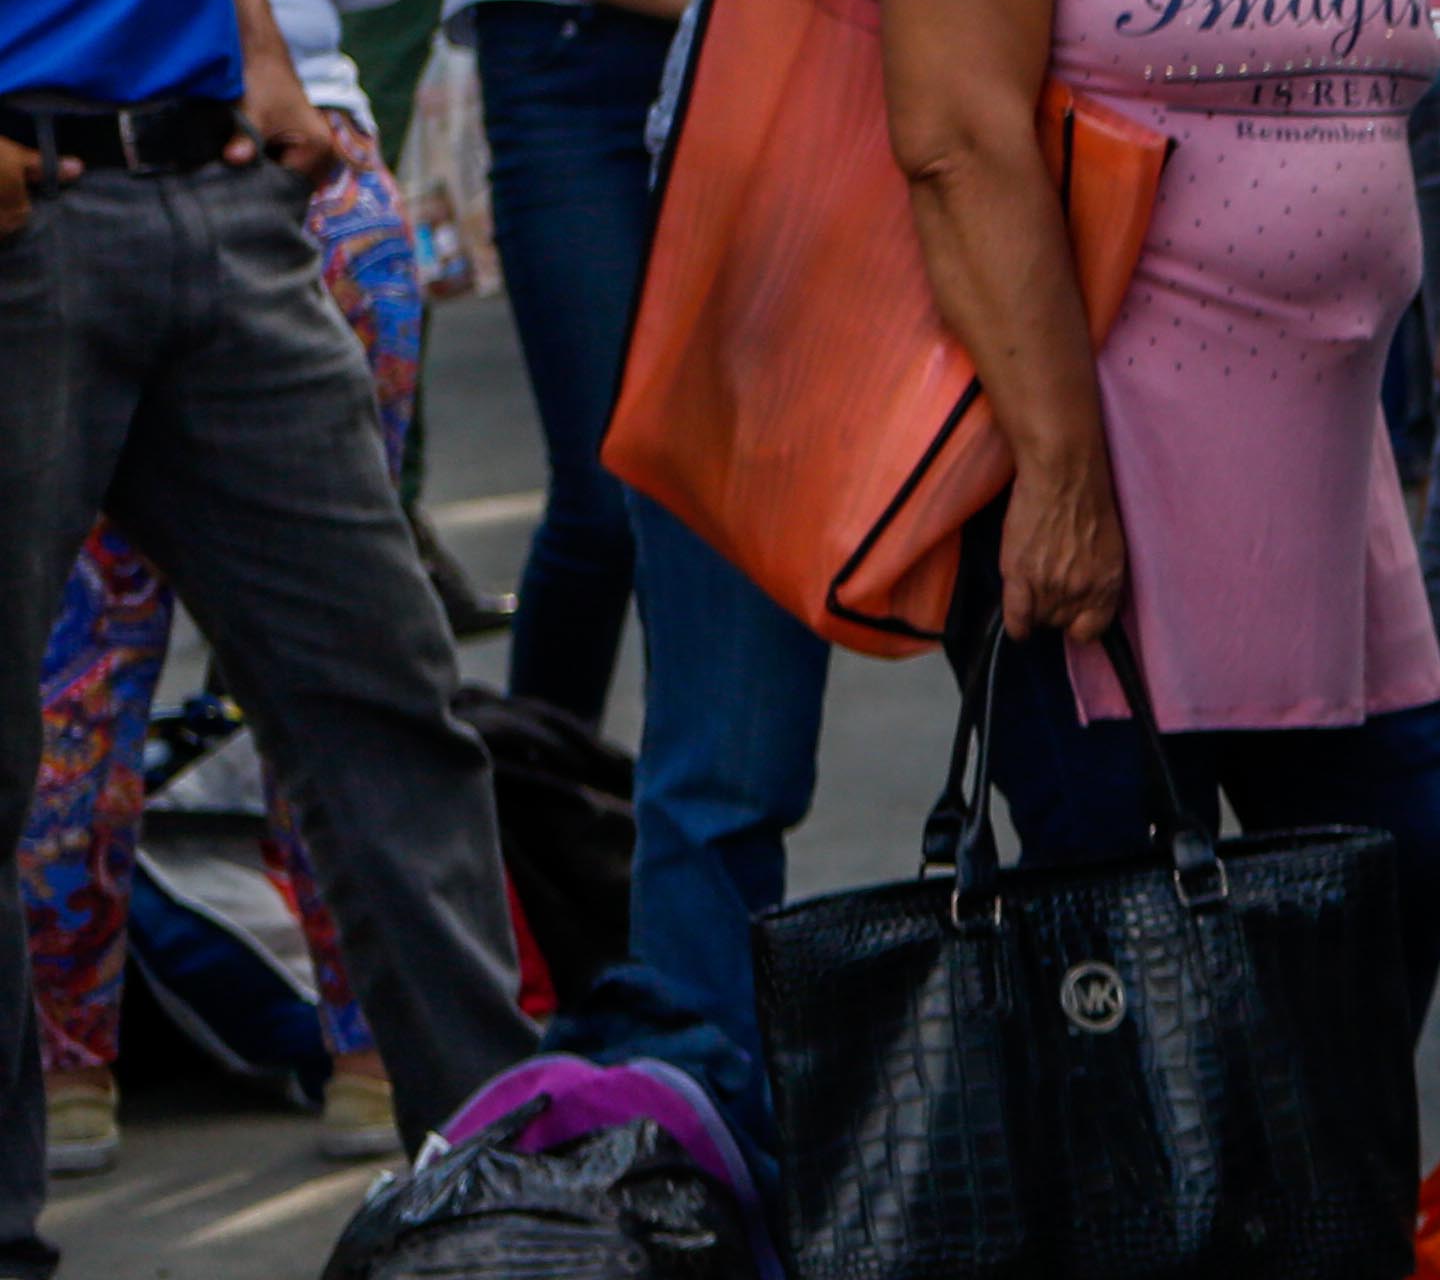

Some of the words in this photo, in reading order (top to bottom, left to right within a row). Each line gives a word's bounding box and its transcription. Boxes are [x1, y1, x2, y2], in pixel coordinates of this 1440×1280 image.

[1250, 80, 1294, 108] IS
[1312, 79, 1403, 107] REAL
[1236, 120, 1376, 145] Remember
